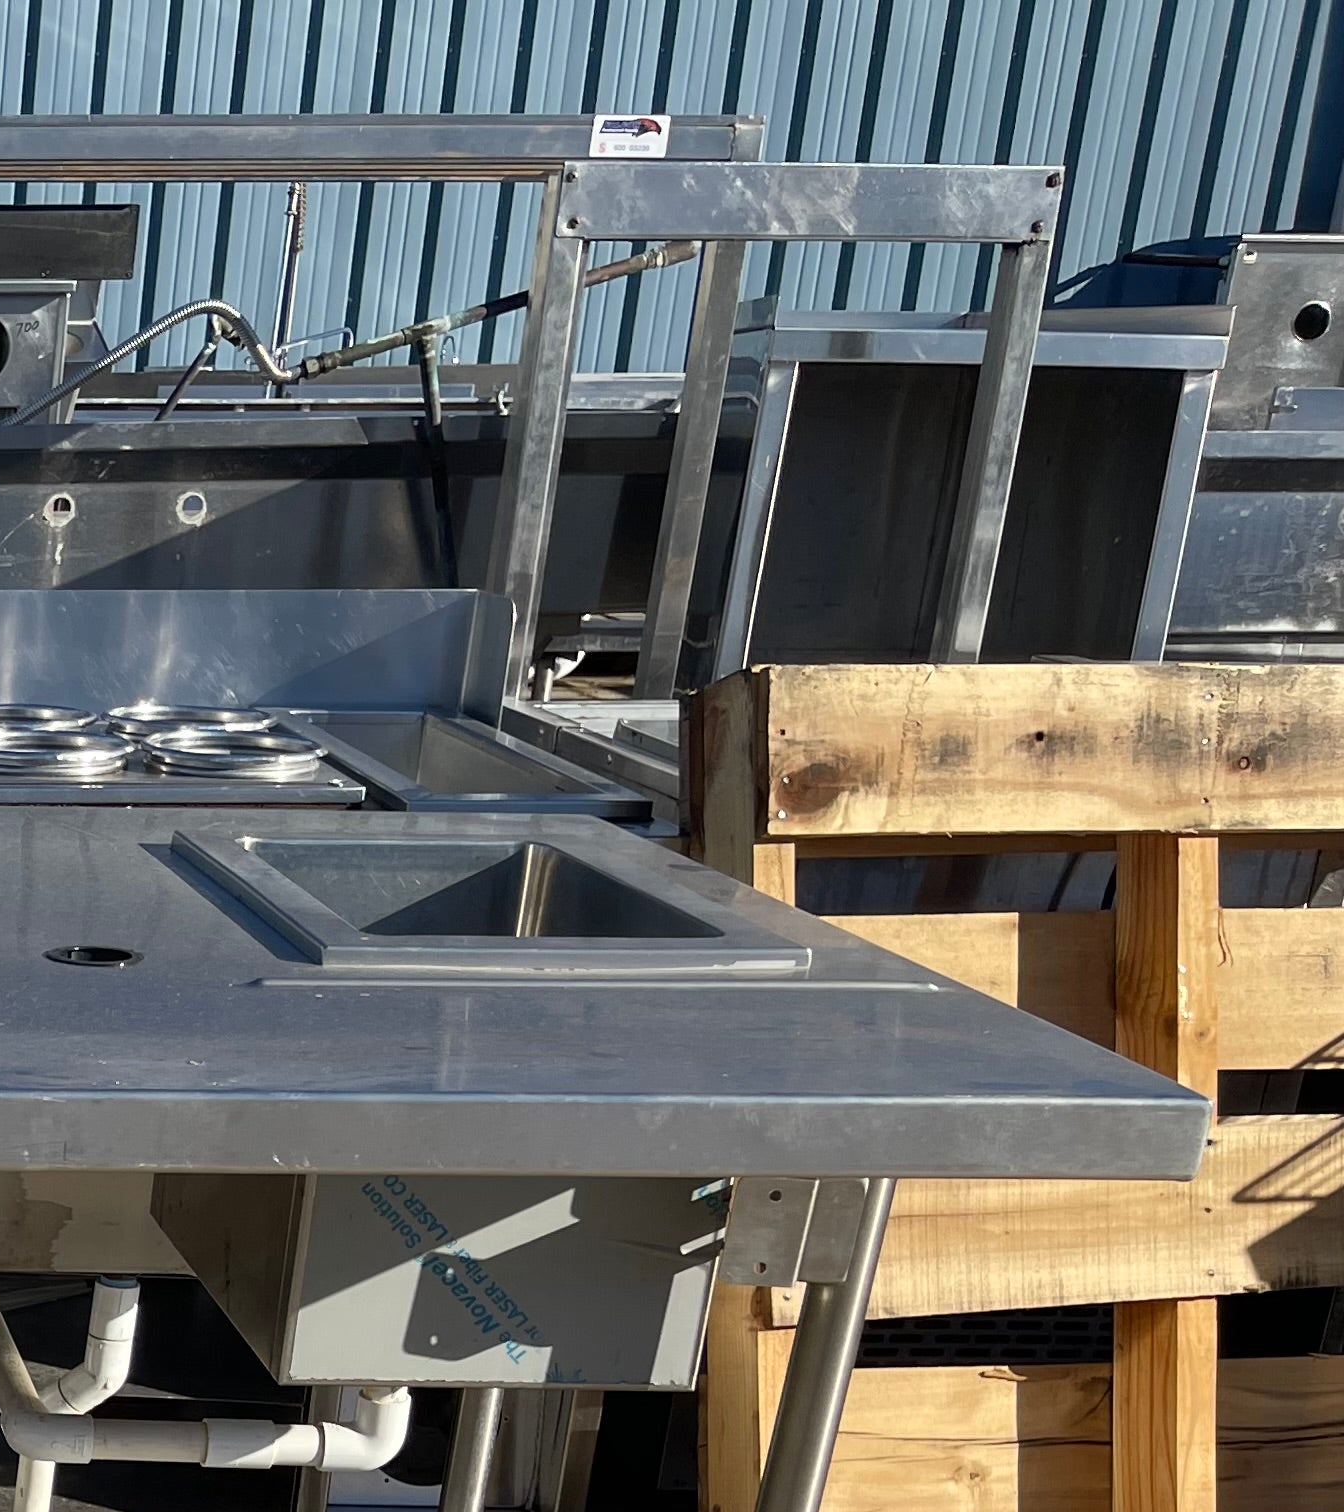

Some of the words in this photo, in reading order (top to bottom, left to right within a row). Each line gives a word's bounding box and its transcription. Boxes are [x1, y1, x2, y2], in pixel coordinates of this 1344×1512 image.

[361, 1182, 422, 1248] Solution
[402, 1193, 449, 1242] LASER
[451, 1246, 489, 1286] Fiber
[484, 1282, 529, 1329] LASER
[500, 1331, 527, 1365] The
